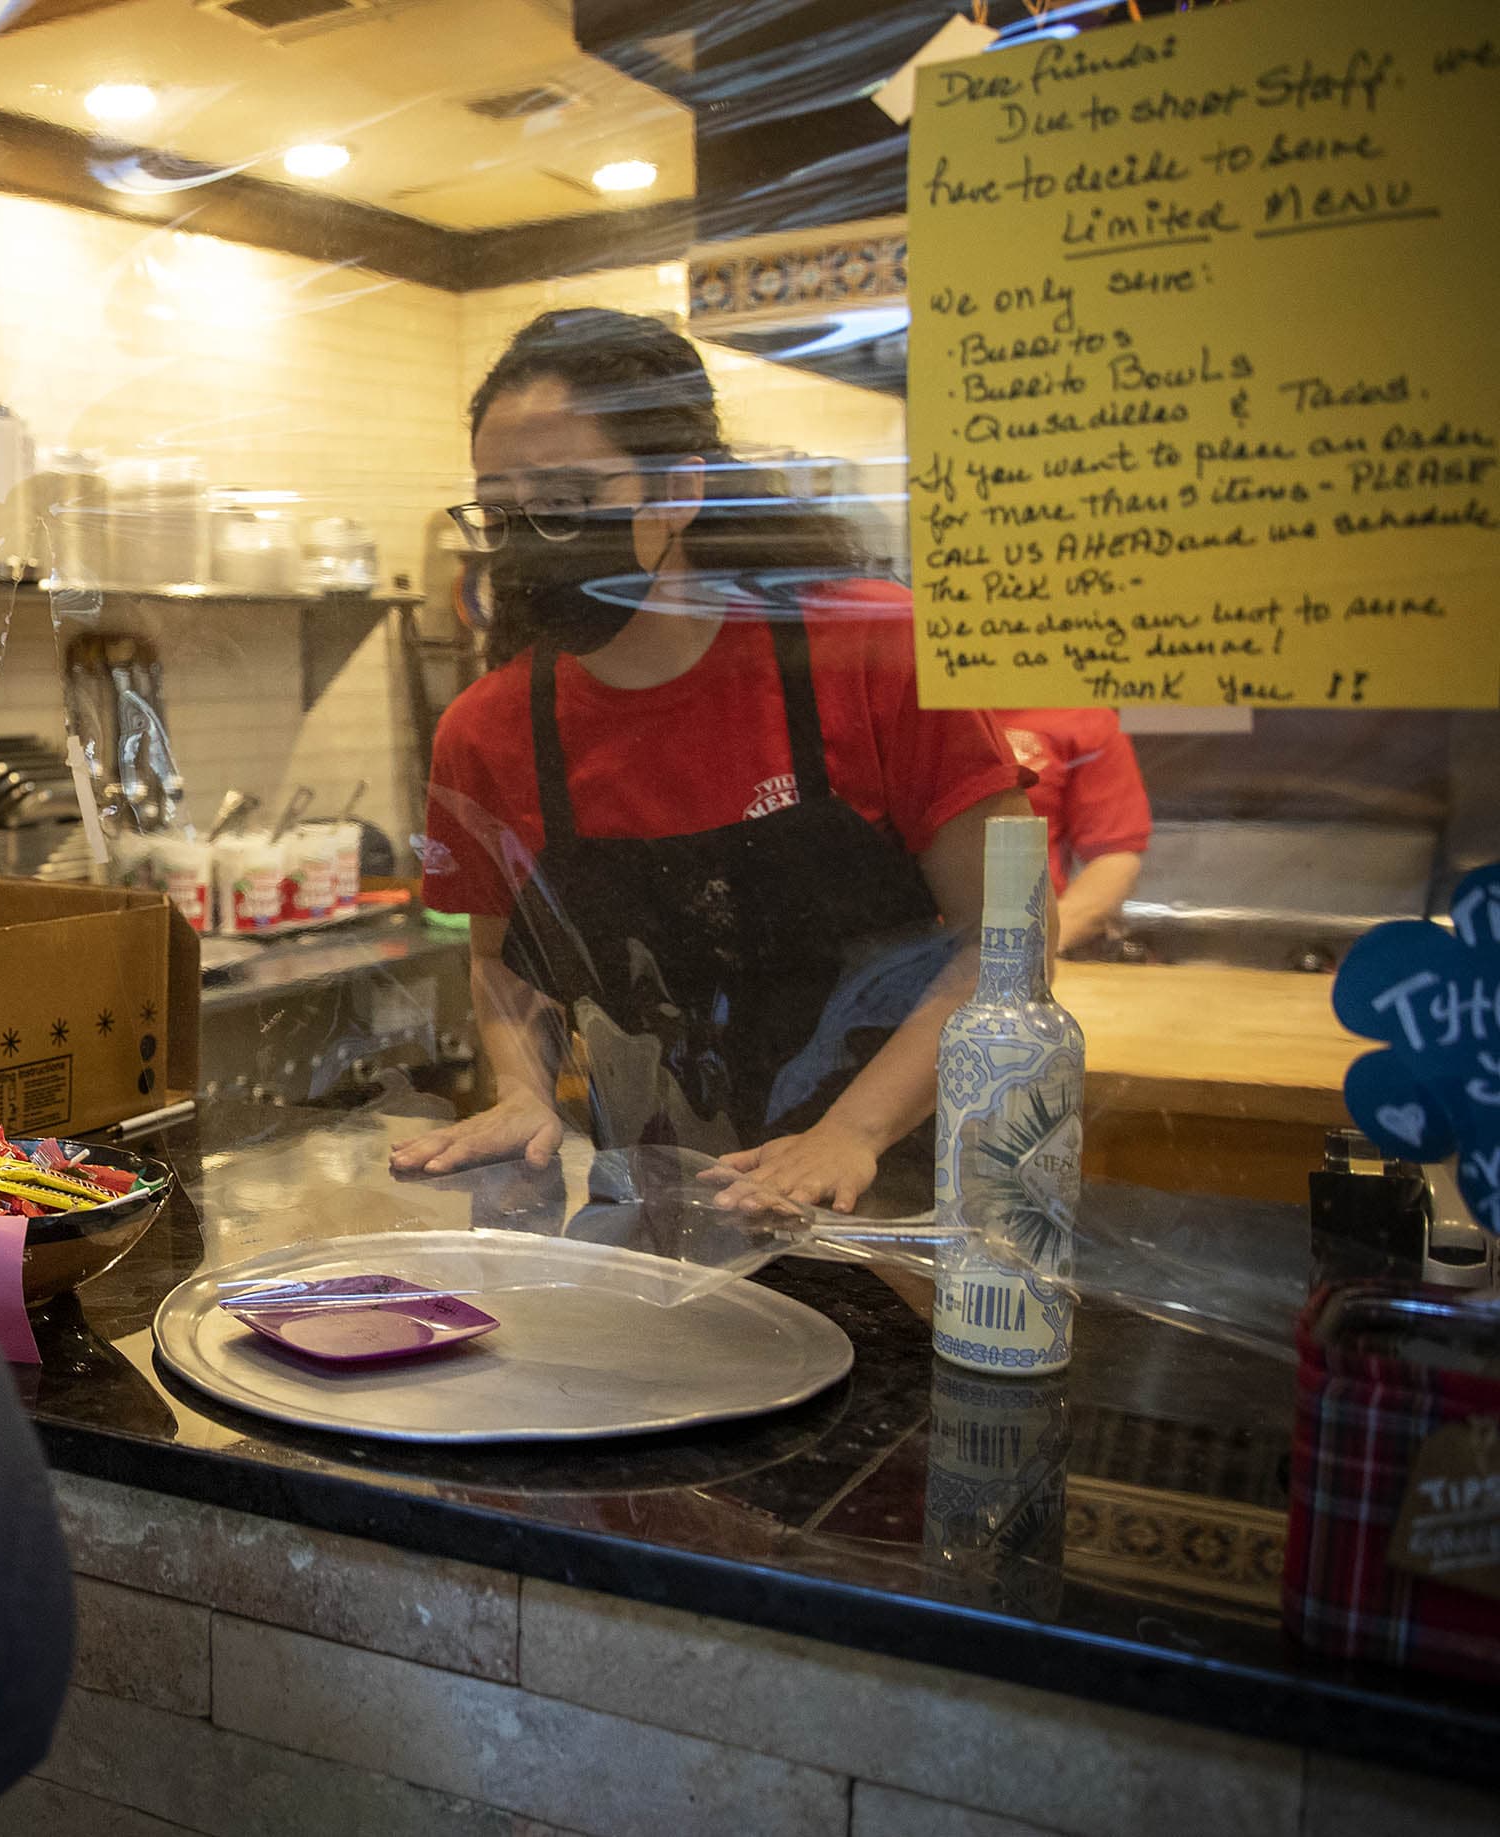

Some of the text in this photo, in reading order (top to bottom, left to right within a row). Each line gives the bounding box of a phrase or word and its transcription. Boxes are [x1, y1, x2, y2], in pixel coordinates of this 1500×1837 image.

[996, 101, 1073, 143] Due
[1080, 95, 1121, 131] to
[924, 155, 1001, 206] have
[1004, 154, 1057, 201] to
[1063, 151, 1191, 194] decide
[1201, 140, 1253, 175] to
[993, 276, 1075, 334] only
[963, 360, 1087, 403] Burrito
[910, 452, 956, 503] If
[966, 461, 1033, 501] you
[1043, 441, 1139, 480] want
[1148, 438, 1182, 469] to
[1307, 436, 1368, 457] an
[922, 503, 969, 545] for
[1348, 456, 1497, 493] PLEASE
[926, 545, 992, 569] CALL
[1004, 541, 1045, 567] US
[1056, 527, 1174, 563] AHEAD
[1175, 524, 1257, 553] and
[1268, 520, 1317, 543] we
[980, 618, 1032, 637] are
[1035, 607, 1127, 647] doing
[1131, 612, 1201, 631] our
[1212, 597, 1283, 624] best
[1295, 592, 1332, 624] to
[936, 646, 997, 679] you
[1012, 650, 1049, 668] as
[1063, 643, 1131, 672] you
[1216, 672, 1295, 706] you
[961, 1280, 1026, 1332] TEQUILA
